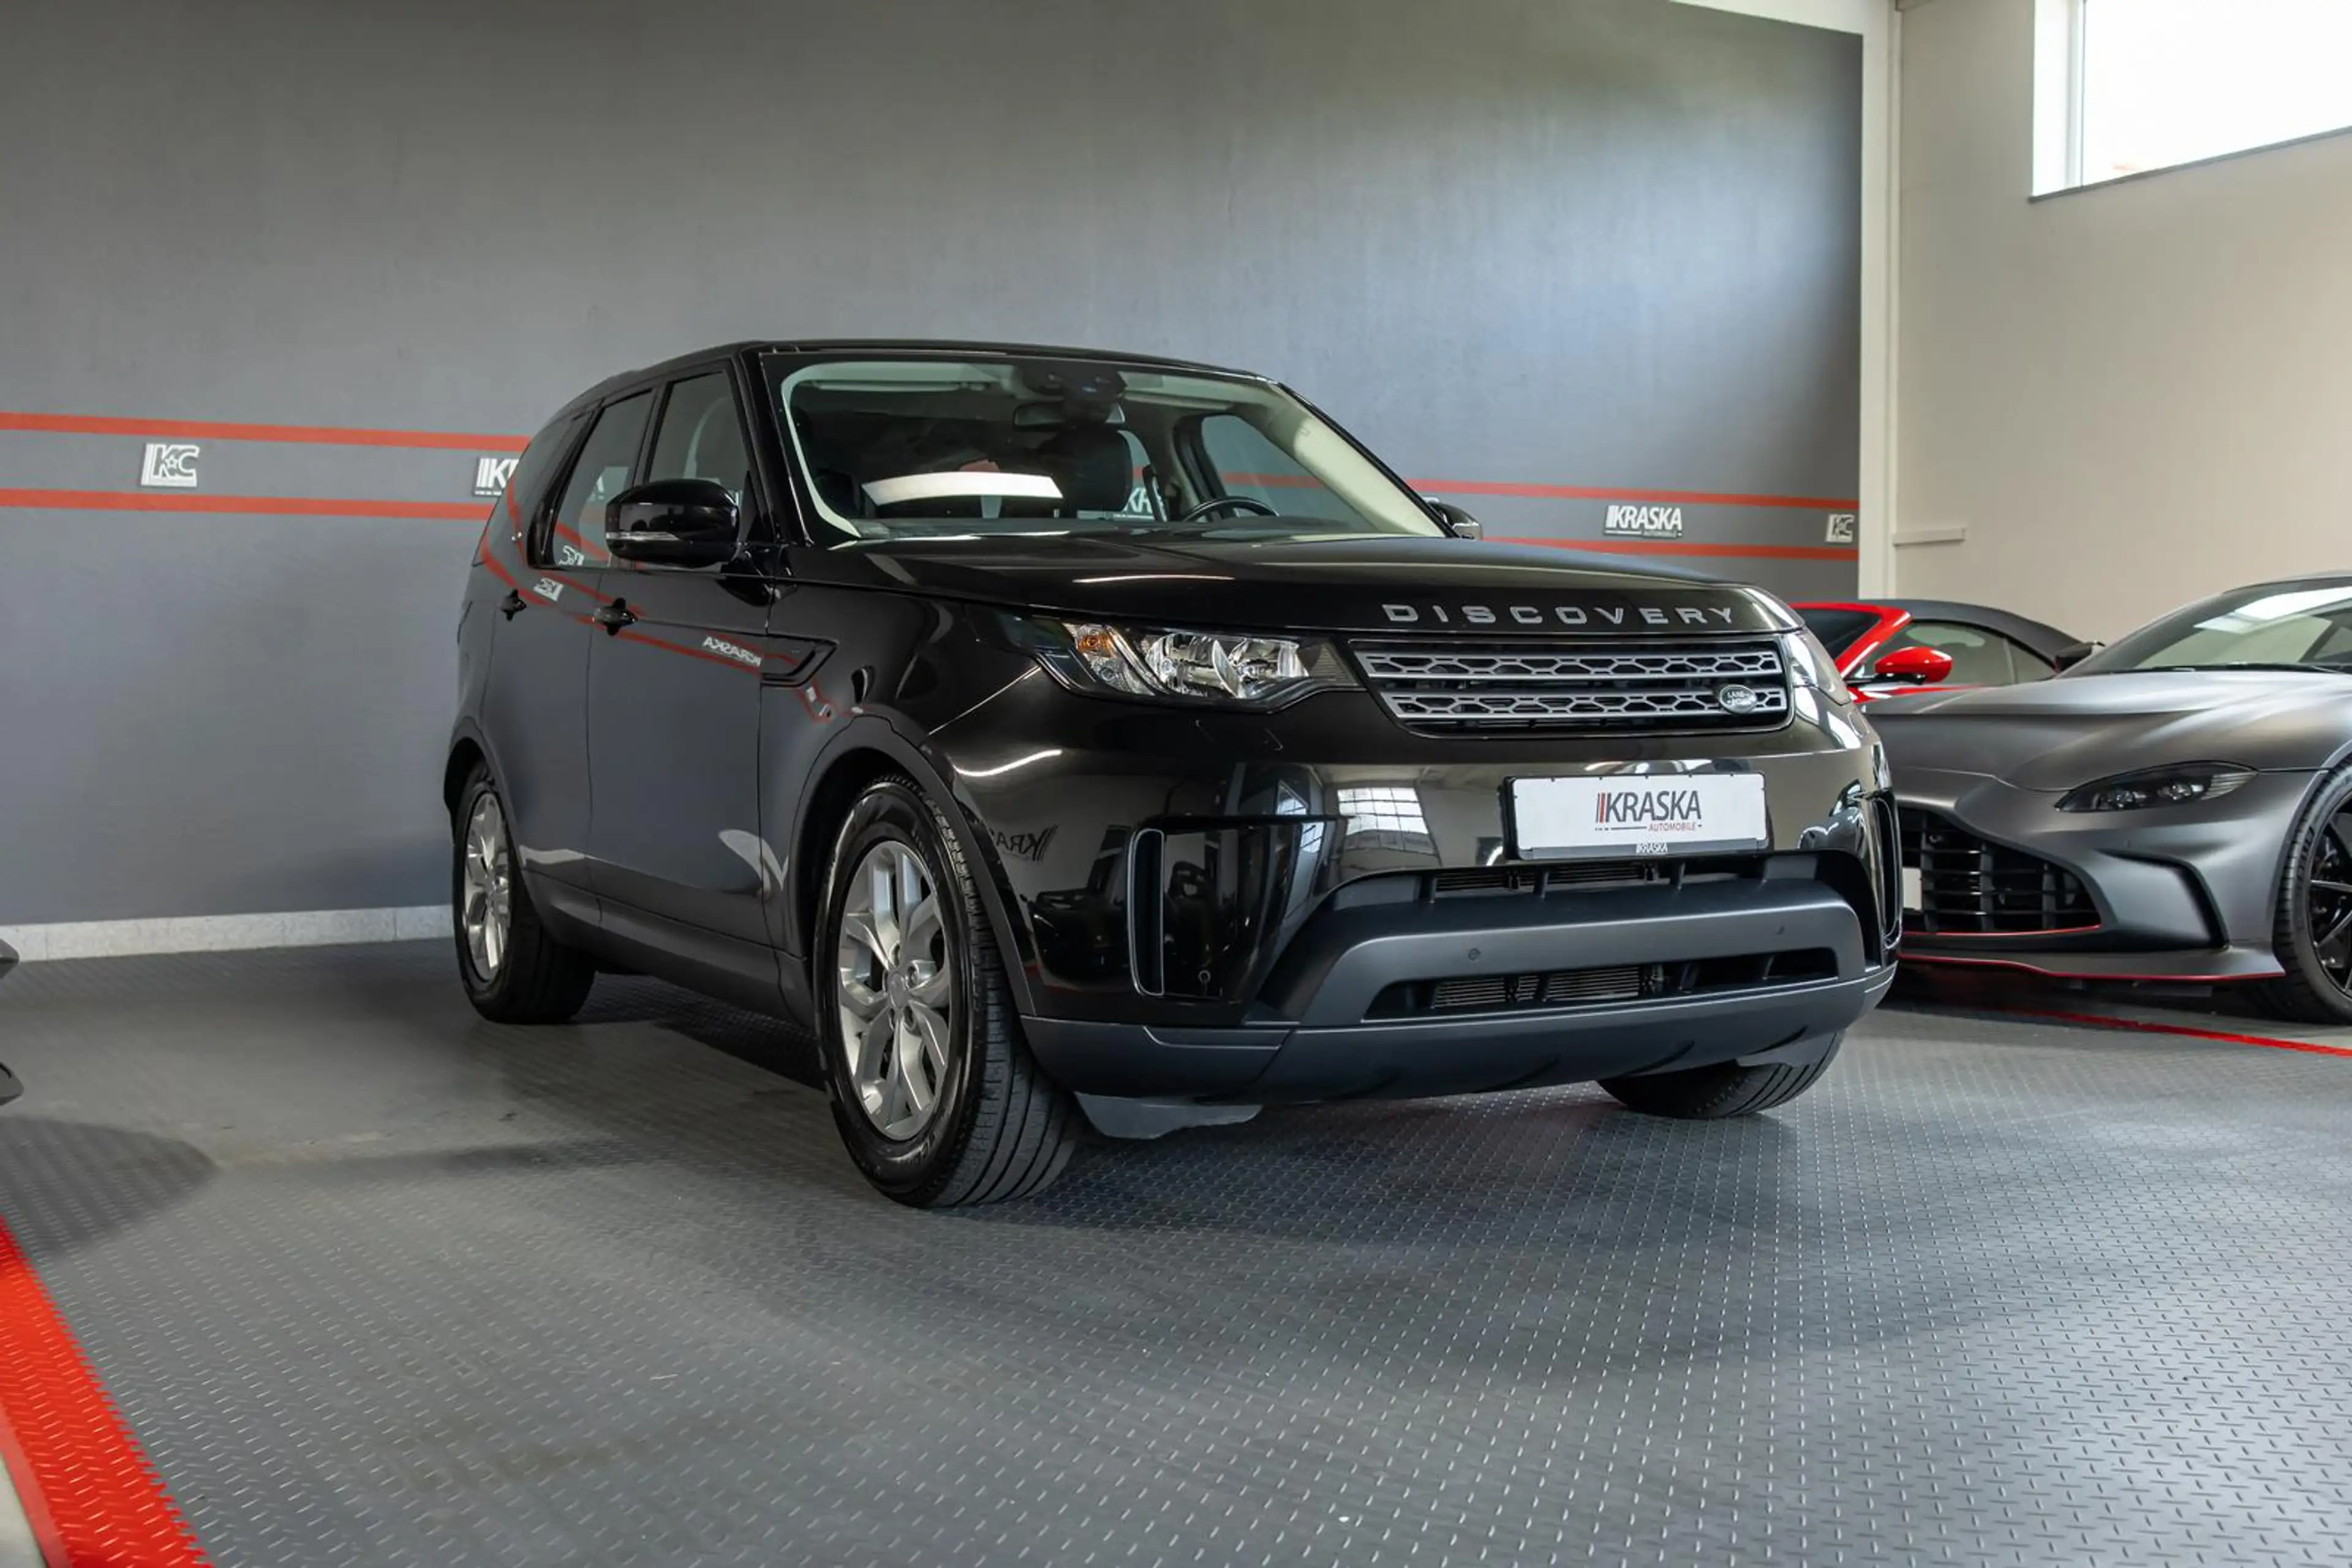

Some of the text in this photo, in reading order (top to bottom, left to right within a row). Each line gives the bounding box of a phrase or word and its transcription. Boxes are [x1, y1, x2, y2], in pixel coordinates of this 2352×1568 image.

[1613, 505, 1683, 530] KRASKA
[1382, 603, 1732, 625] DISCOVERY
[1605, 790, 1702, 823] KRASKA
